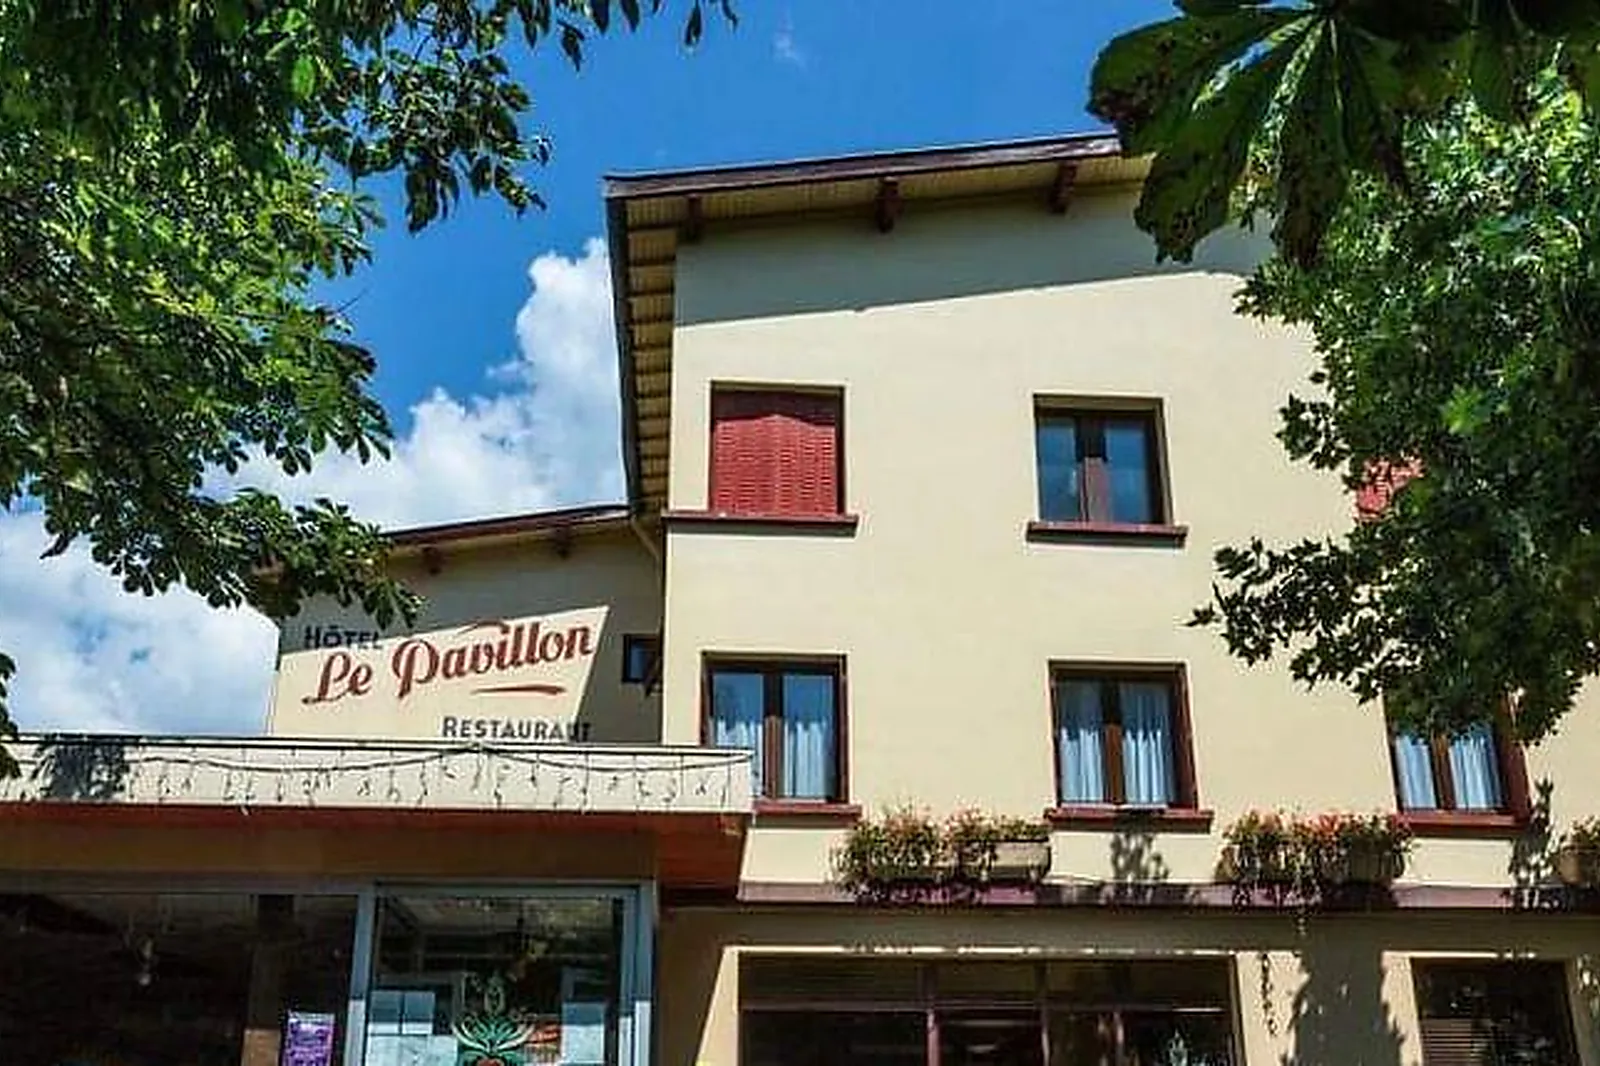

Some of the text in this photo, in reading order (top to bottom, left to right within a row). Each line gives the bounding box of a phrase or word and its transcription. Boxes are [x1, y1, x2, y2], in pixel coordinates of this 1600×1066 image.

[304, 624, 382, 649] HÔTEL
[301, 621, 594, 704] Le Pavillon
[442, 716, 591, 742] RESTAURANT
